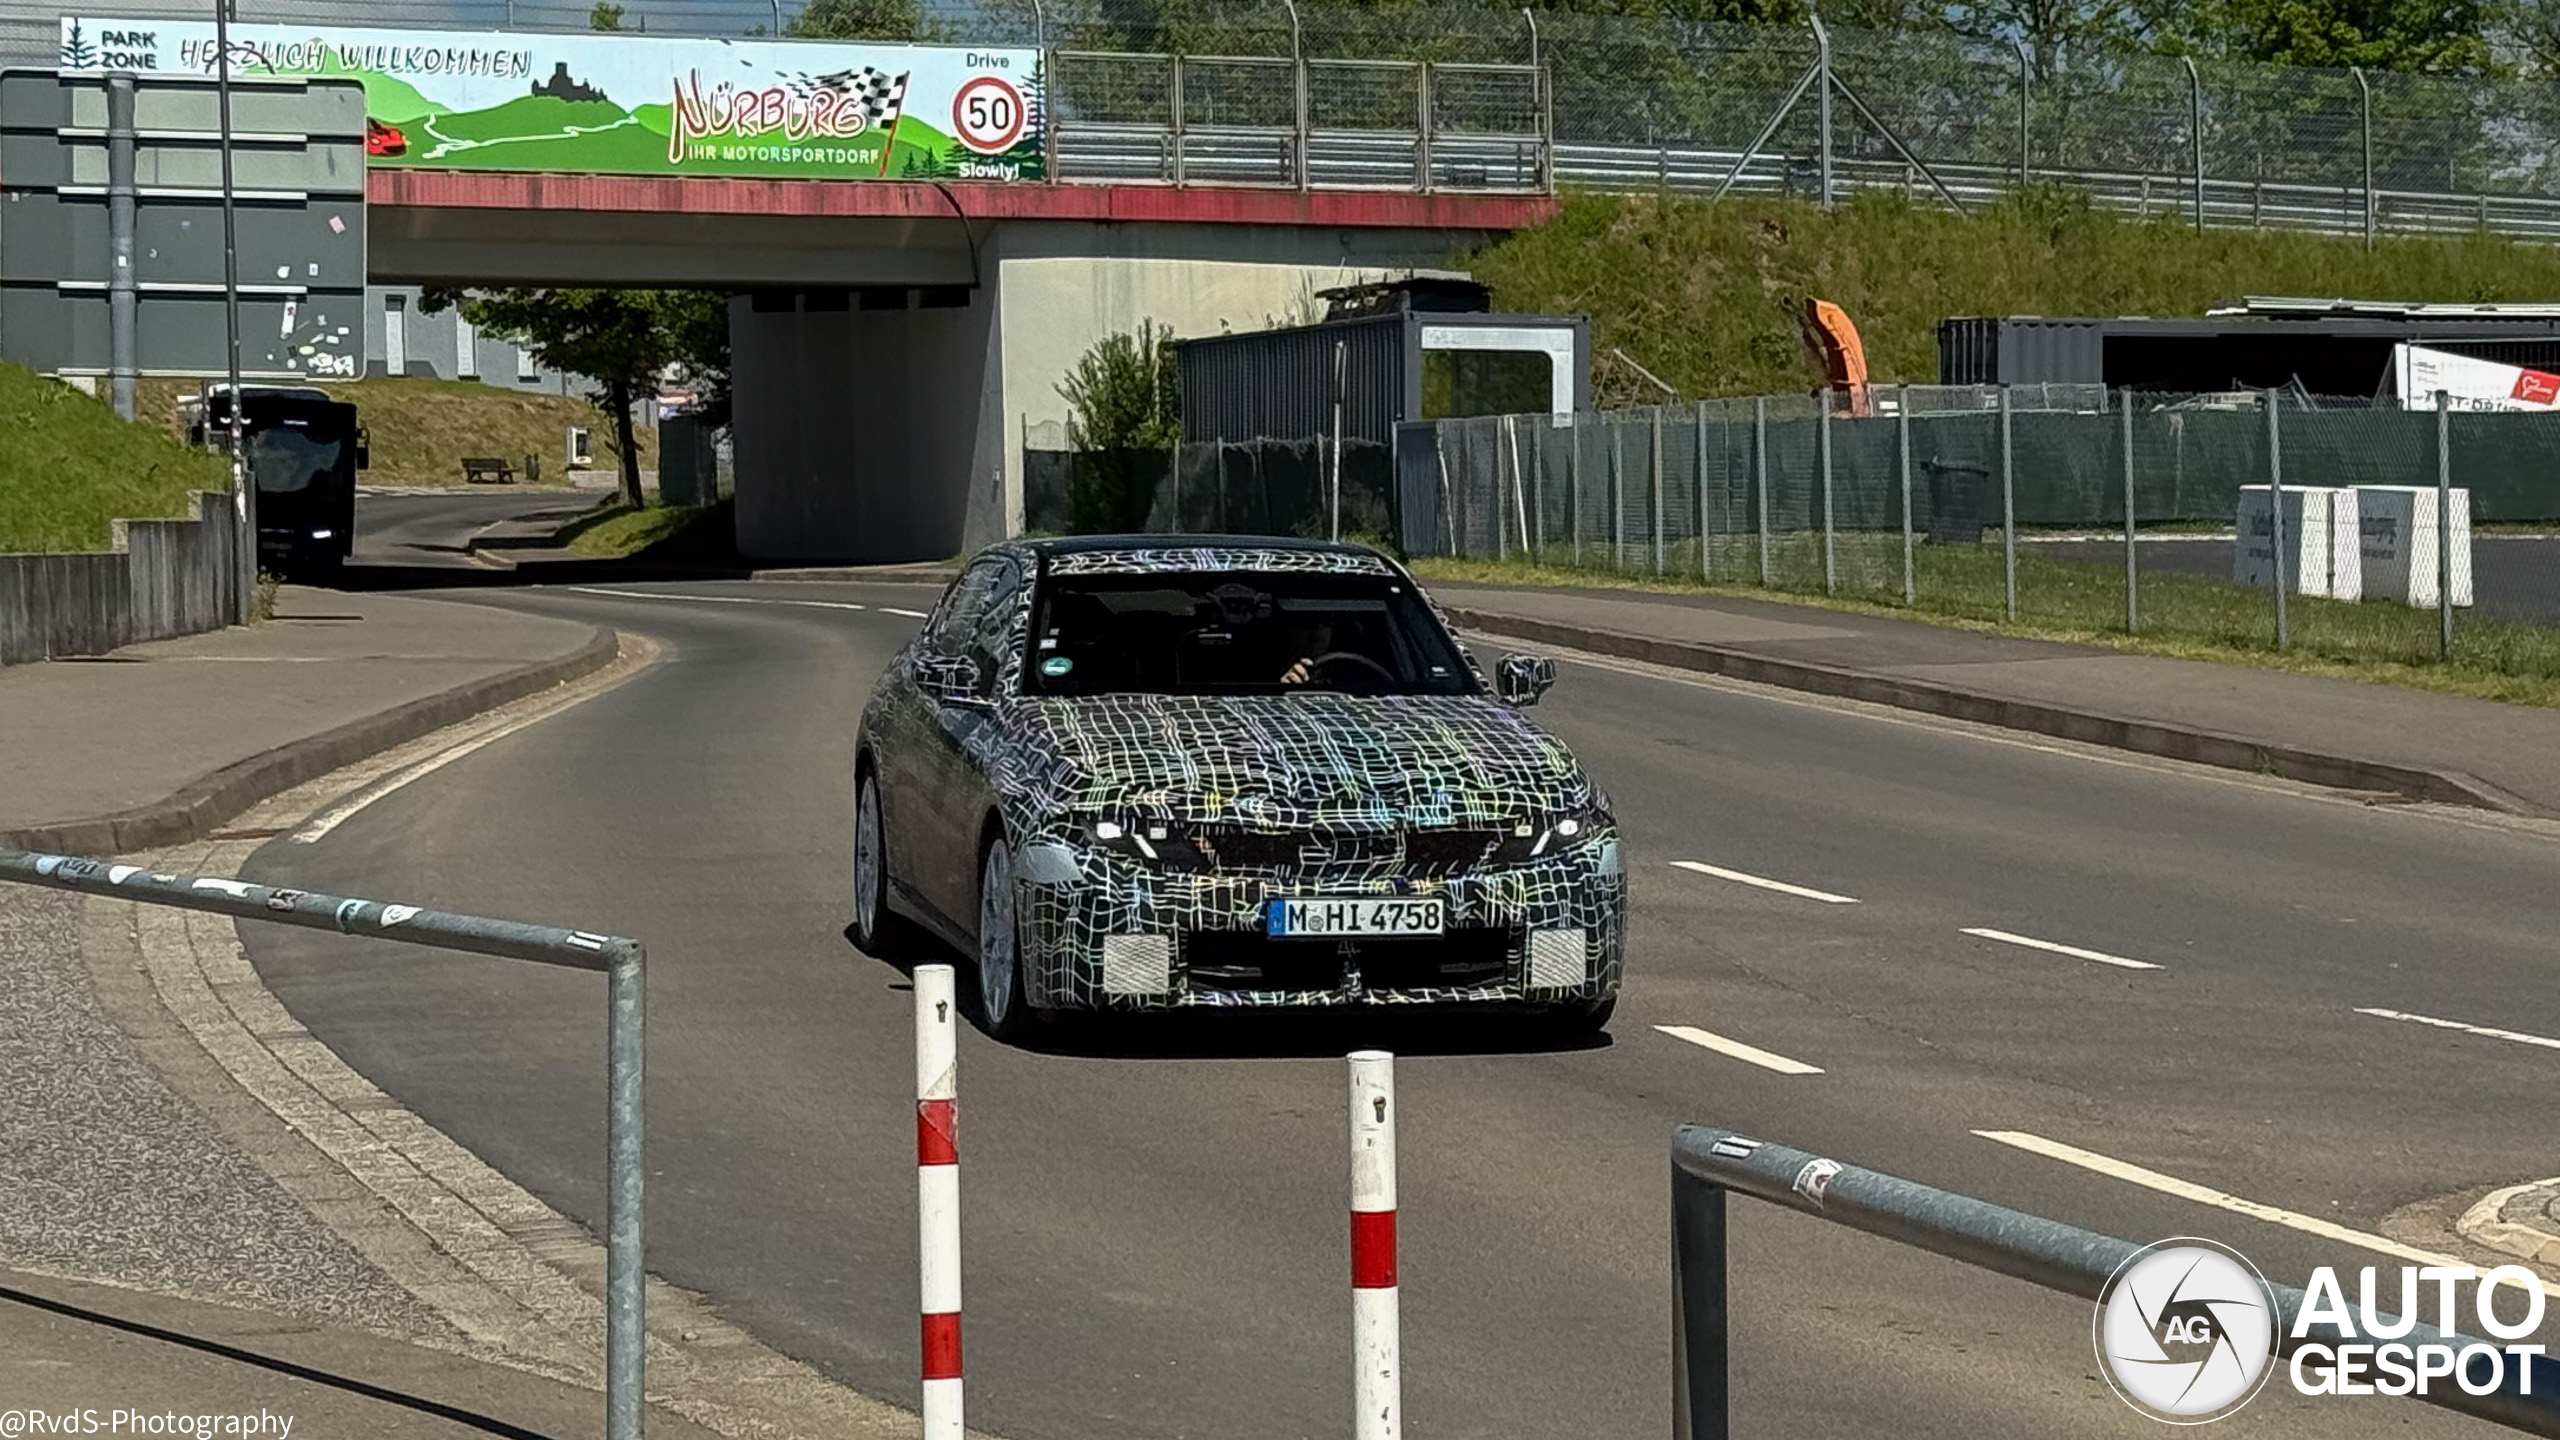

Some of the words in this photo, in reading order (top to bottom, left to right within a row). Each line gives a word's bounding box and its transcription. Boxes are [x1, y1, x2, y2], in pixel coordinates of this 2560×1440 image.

[101, 30, 159, 50] PARK
[101, 51, 159, 70] ZONE
[180, 37, 327, 73] HERZLICH
[337, 42, 532, 79] WILLKOMMEN
[966, 52, 1010, 69] Drive
[668, 67, 868, 164] NÜRBURG
[969, 96, 1010, 130] 50
[688, 144, 717, 160] IHR
[723, 145, 880, 165] MOTORSPORTDORF
[958, 161, 1020, 182] Slowly!
[1288, 903, 1308, 932] M
[1325, 903, 1362, 932] HI
[1369, 901, 1441, 932] 4758
